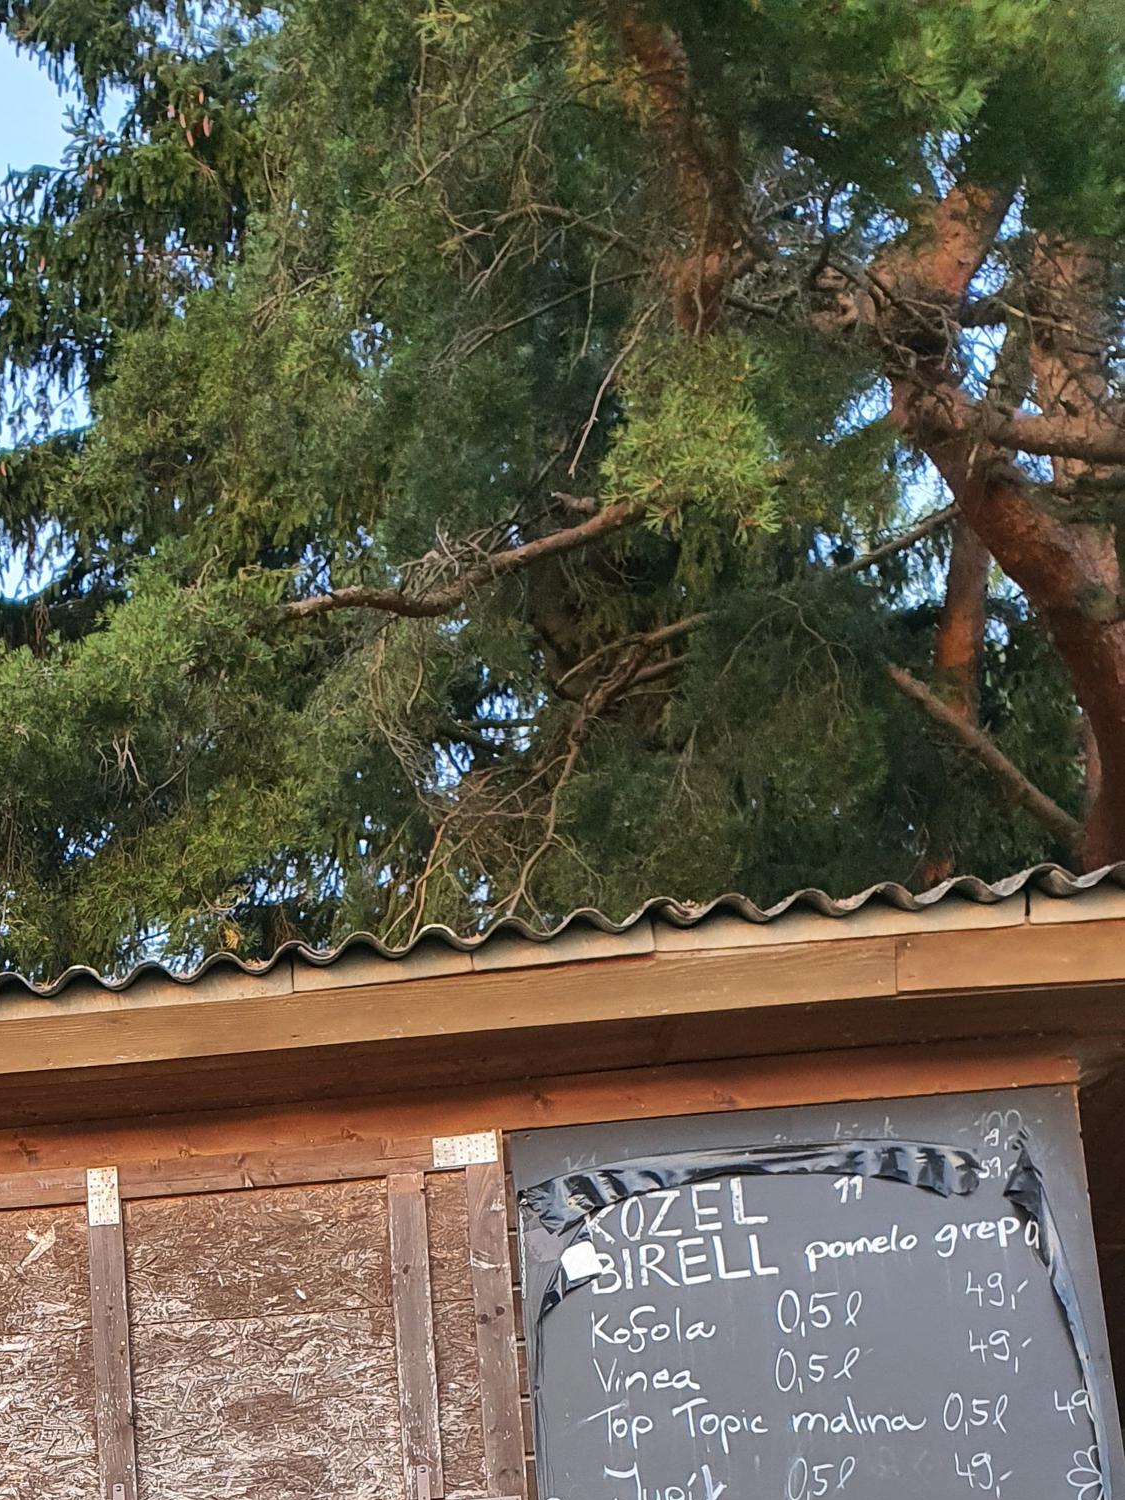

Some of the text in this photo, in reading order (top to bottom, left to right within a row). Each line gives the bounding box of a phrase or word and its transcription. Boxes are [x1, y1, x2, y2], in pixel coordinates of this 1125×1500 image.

[585, 1177, 769, 1244] KOZEL
[591, 1234, 779, 1295] BIRELL
[804, 1224, 918, 1273] pomelo
[591, 1305, 716, 1353] Kofola
[593, 1358, 701, 1392] Vinea
[577, 1401, 653, 1449] Top
[672, 1398, 768, 1454] Topic
[792, 1396, 927, 1434] malina
